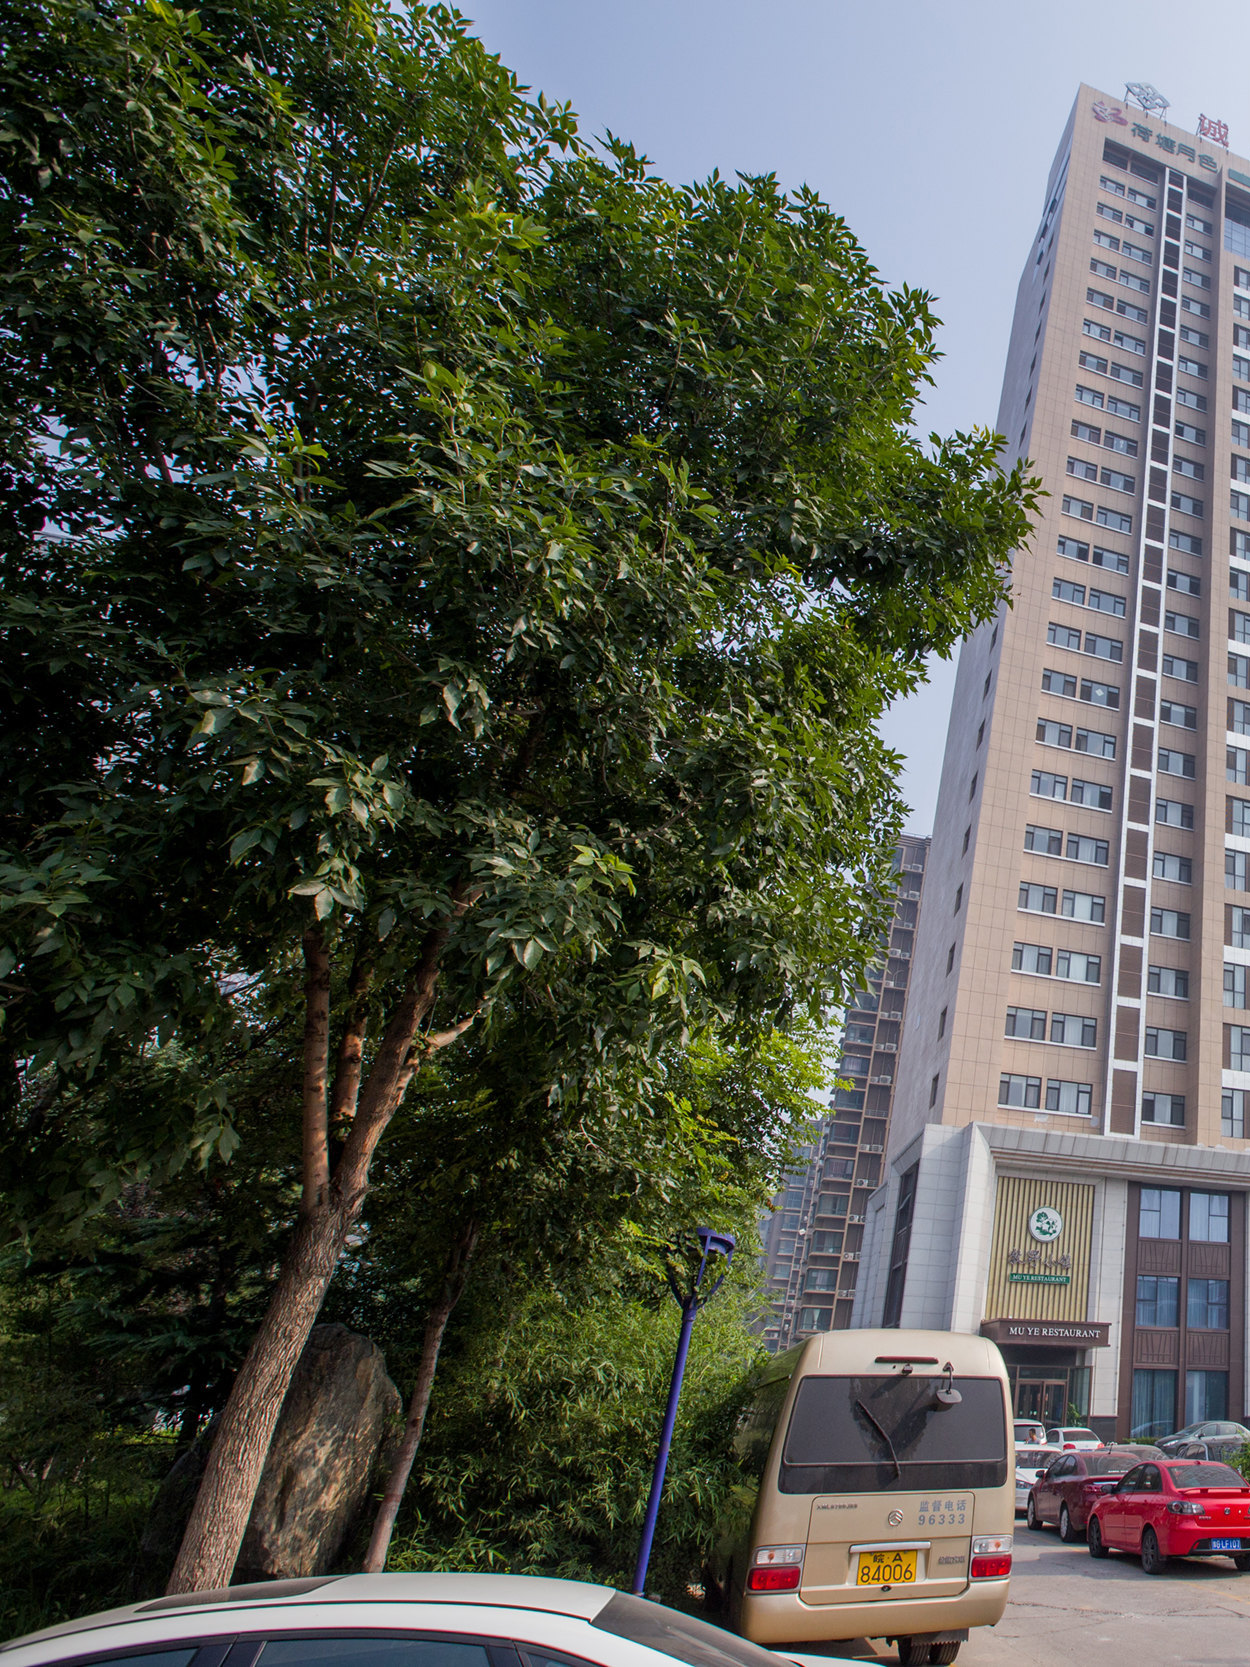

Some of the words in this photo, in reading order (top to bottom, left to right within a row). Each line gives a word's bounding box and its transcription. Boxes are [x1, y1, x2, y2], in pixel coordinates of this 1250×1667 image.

[1131, 122, 1218, 174] 荷塘月色
[1009, 1326, 1025, 1335] MU
[1027, 1327, 1040, 1336] YE
[1041, 1327, 1101, 1338] RESTAURANT
[919, 1499, 967, 1512] 监督电话
[918, 1513, 966, 1526] 96333
[860, 1563, 913, 1583] 84006
